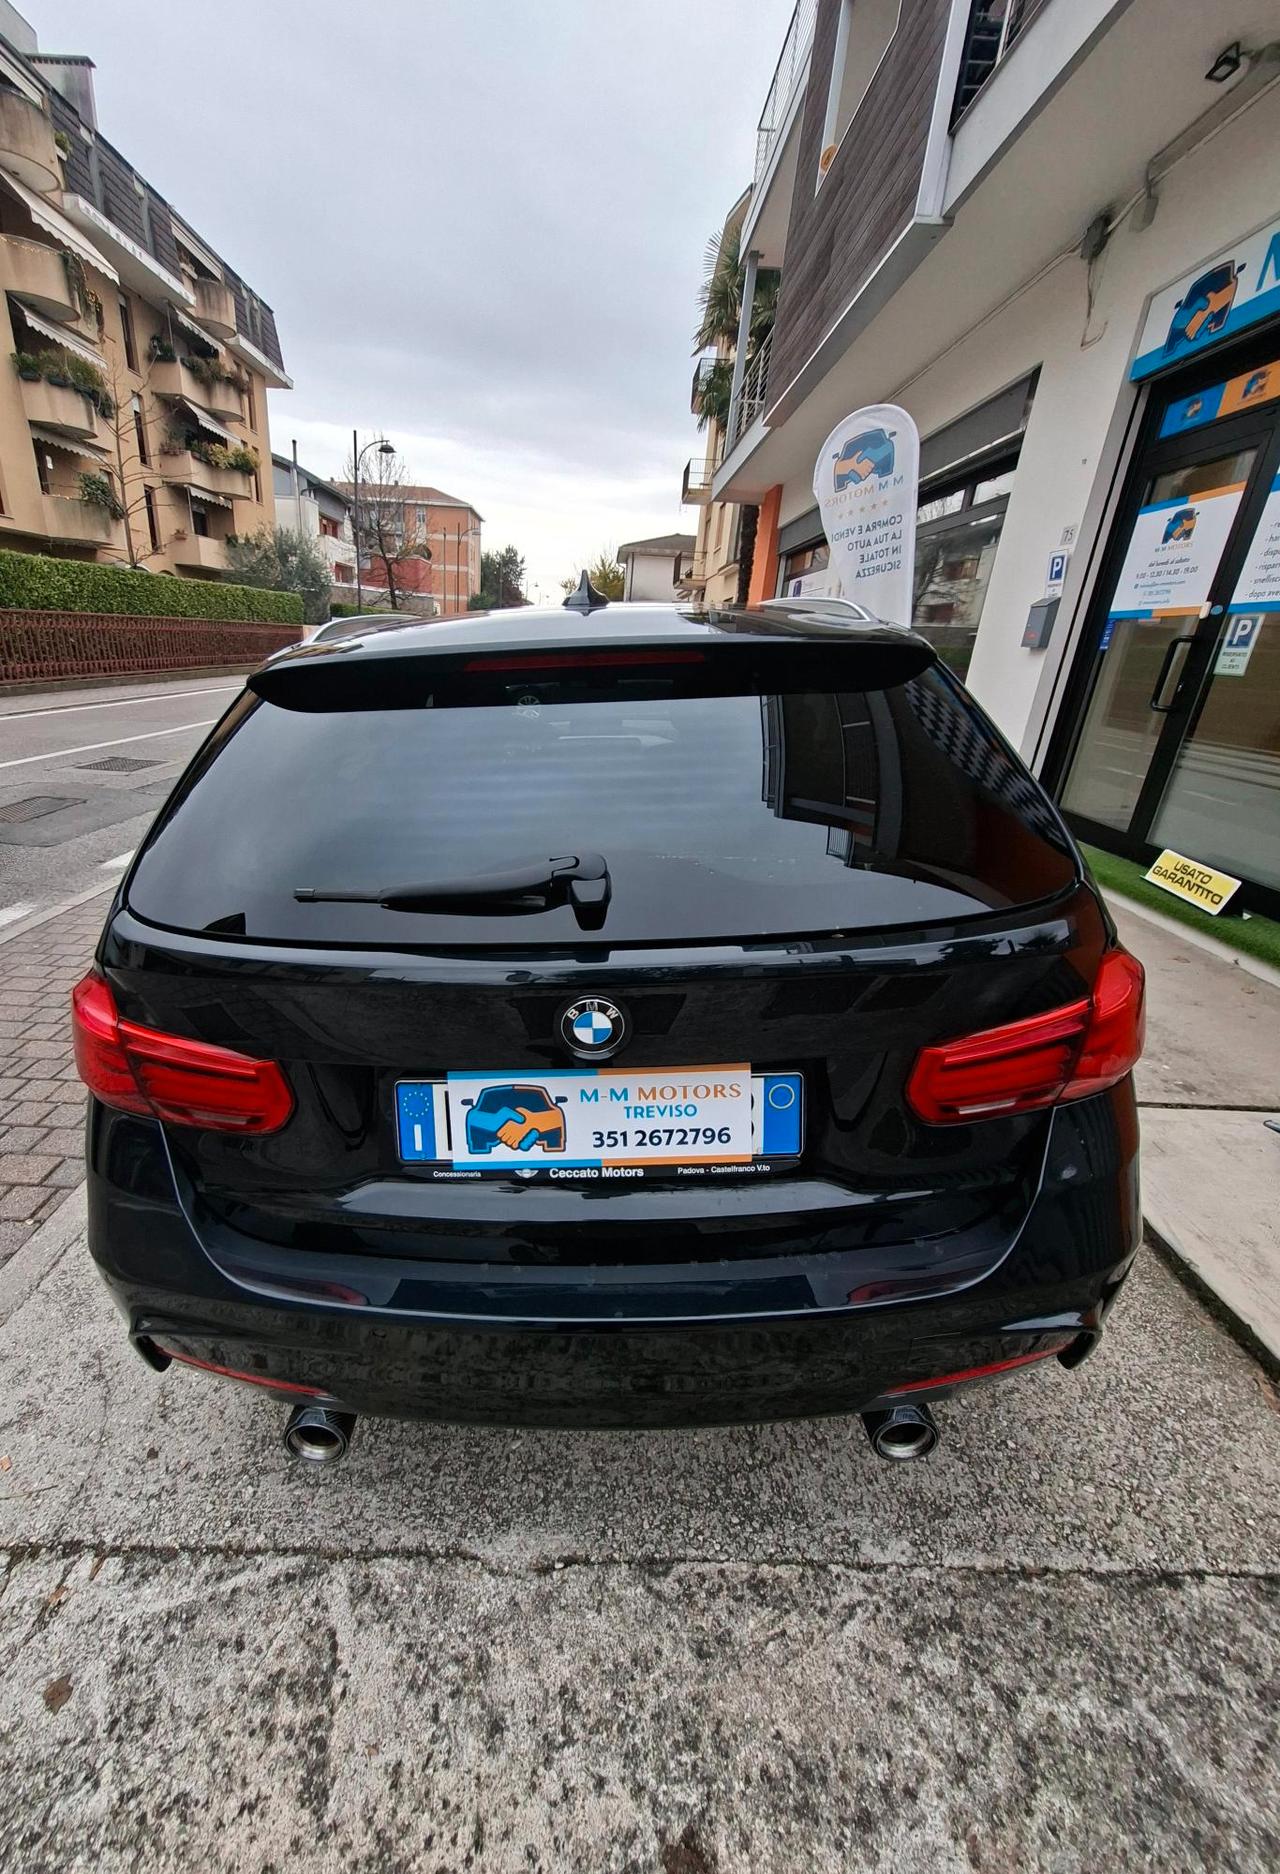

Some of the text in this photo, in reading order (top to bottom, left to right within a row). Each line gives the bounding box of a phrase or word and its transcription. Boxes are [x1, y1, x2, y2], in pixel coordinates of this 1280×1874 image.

[1052, 558, 1062, 578] P
[1232, 619, 1252, 645] P
[1173, 860, 1213, 885] USATO
[1152, 865, 1224, 906] GARANTITO
[566, 1001, 619, 1020] BMW
[579, 1083, 742, 1103] M-M MOTORS
[624, 1104, 698, 1119] TREVISO
[592, 1126, 732, 1148] 351 2672796
[432, 1170, 482, 1178] Concessionaria
[549, 1167, 600, 1179] Ceccato
[601, 1167, 645, 1178] Motors
[677, 1166, 705, 1175] Padova
[710, 1165, 756, 1174] Castelfranco
